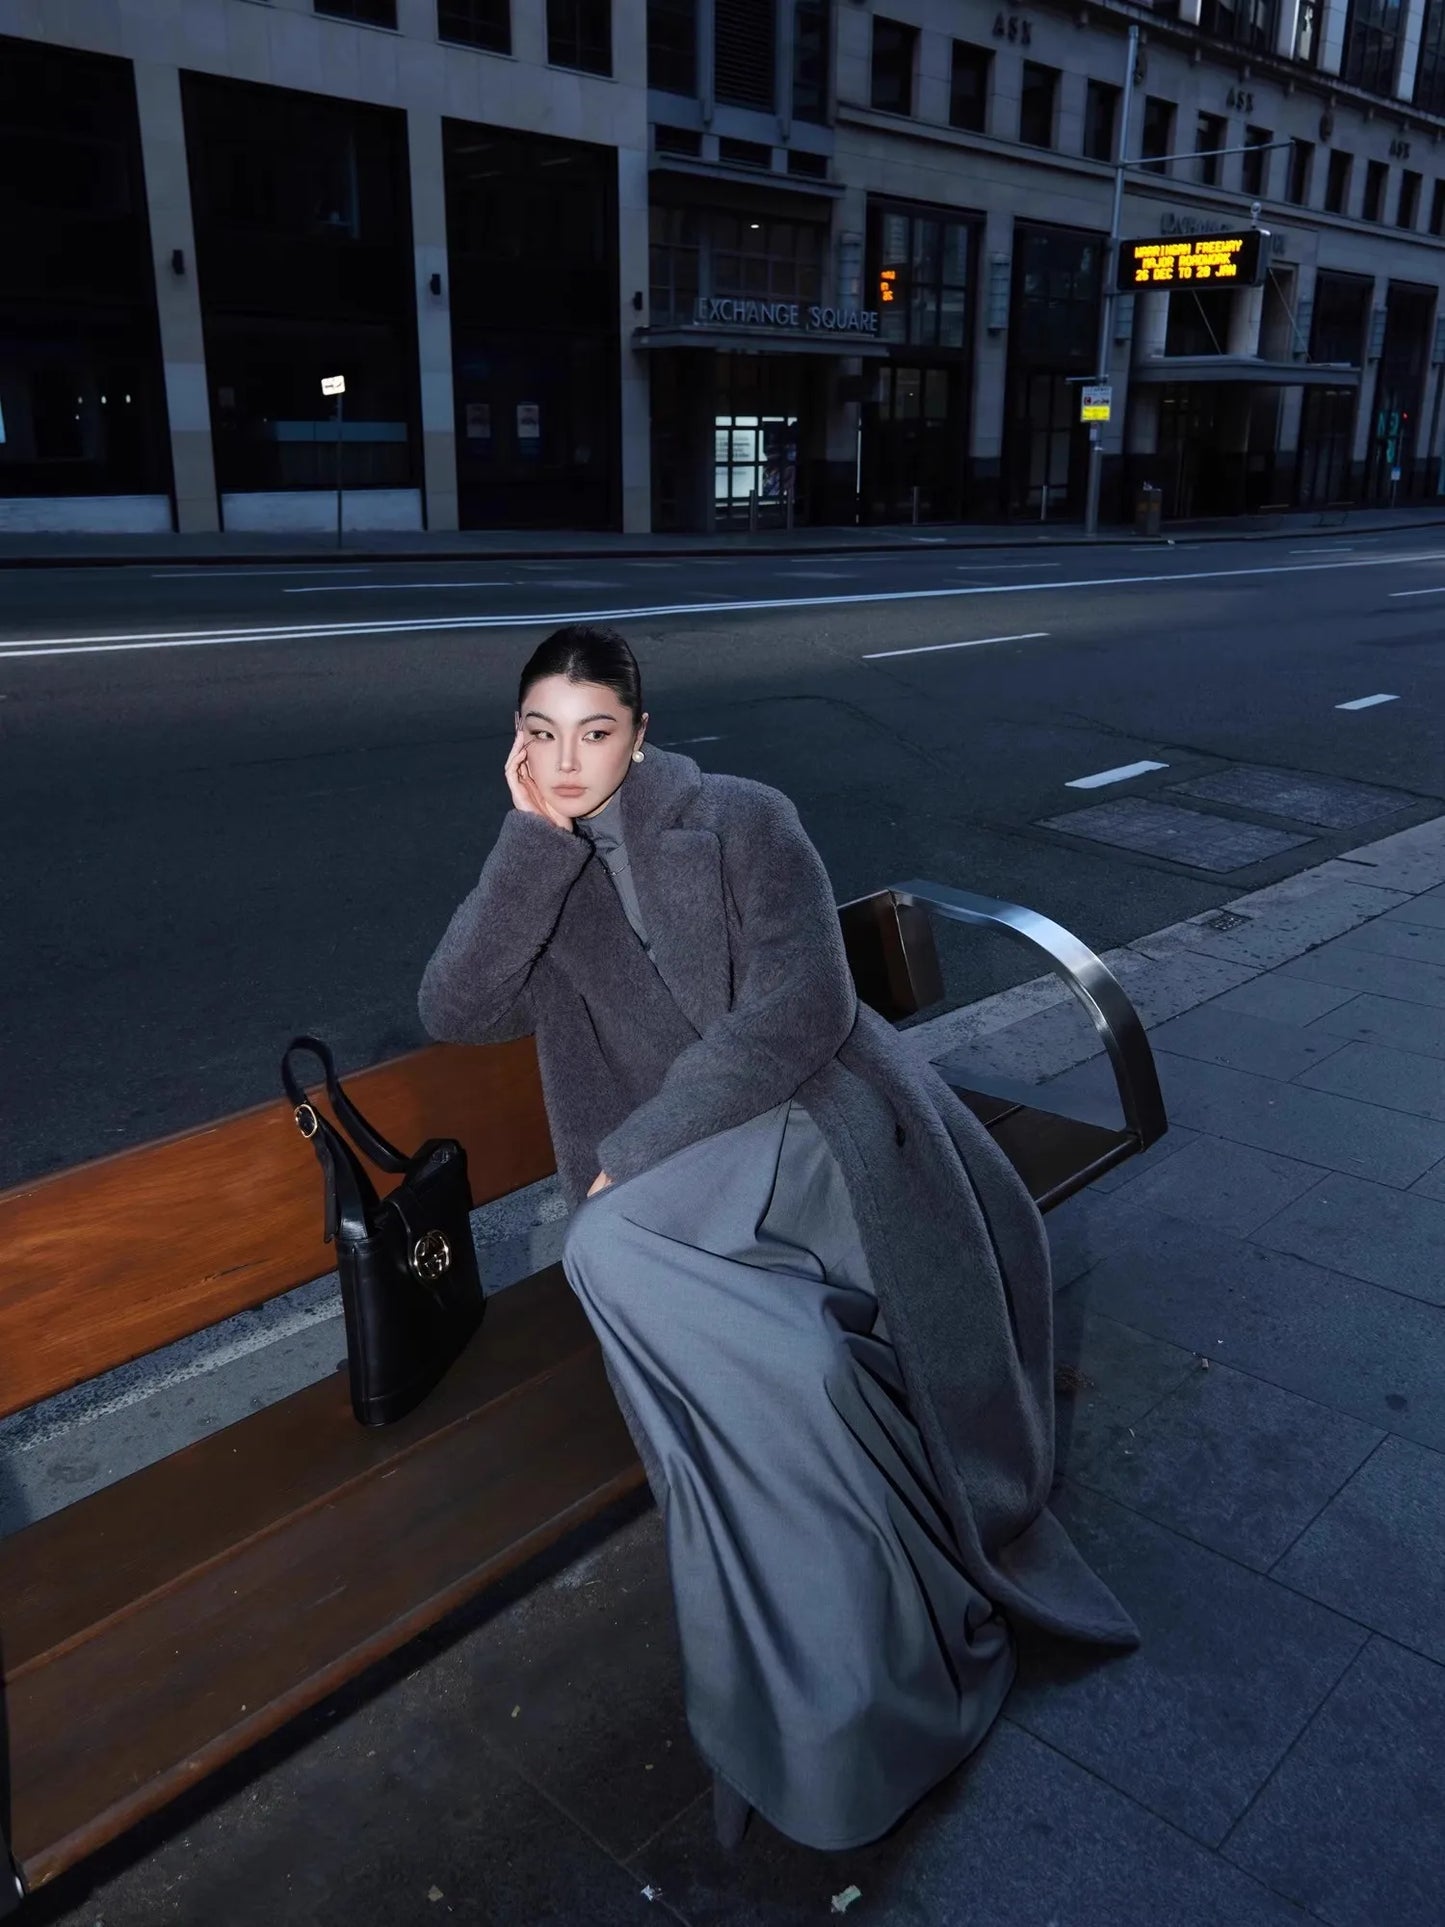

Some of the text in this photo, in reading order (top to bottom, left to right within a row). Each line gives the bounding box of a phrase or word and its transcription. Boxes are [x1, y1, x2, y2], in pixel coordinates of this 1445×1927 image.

[1195, 239, 1243, 254] FREEWAY
[1142, 253, 1231, 269] MAJOR ROADWORK
[1153, 268, 1174, 280] DEC
[1178, 267, 1192, 279] TO
[1215, 264, 1237, 277] JAN
[697, 297, 879, 331] EXCHANGE SQUARE
